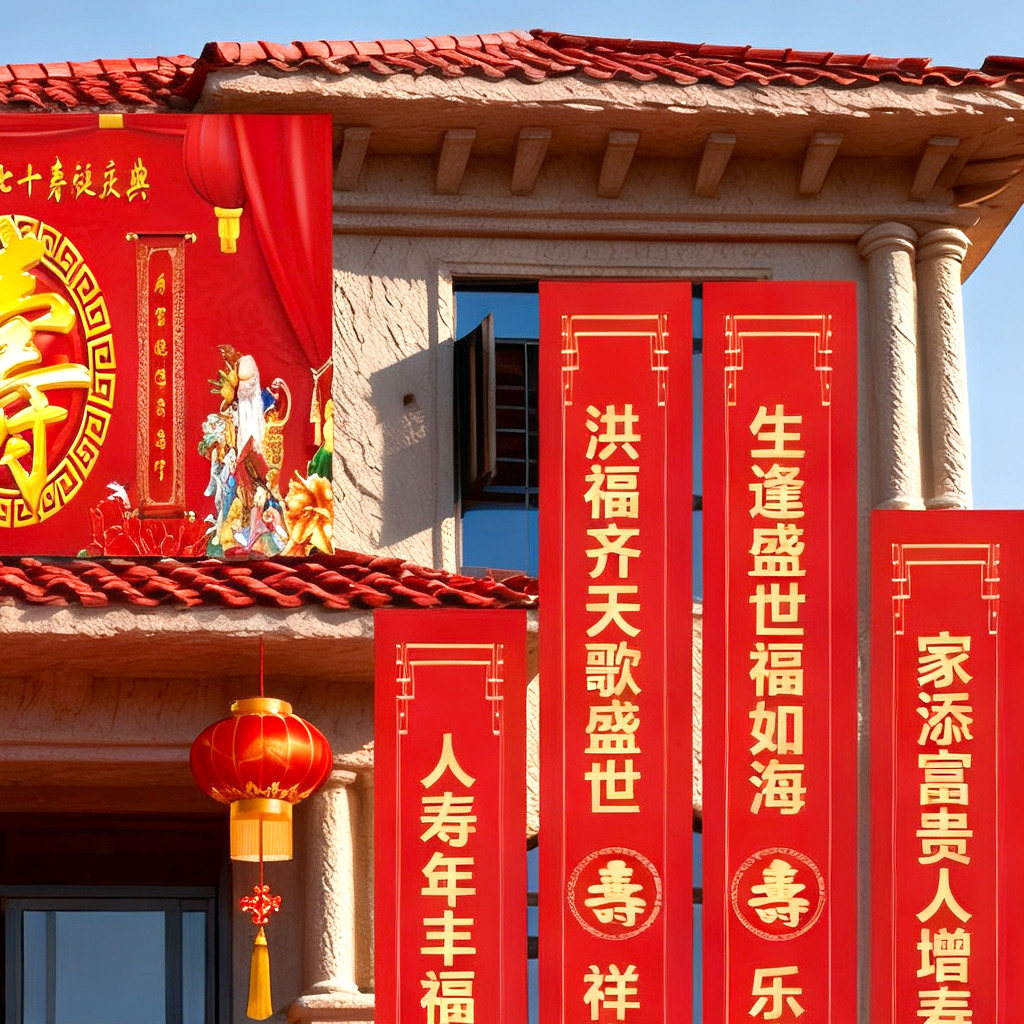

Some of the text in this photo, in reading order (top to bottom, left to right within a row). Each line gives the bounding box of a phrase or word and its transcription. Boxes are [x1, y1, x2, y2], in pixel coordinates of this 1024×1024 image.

[584, 404, 641, 812] 洪福齐天歌盛世
[748, 405, 806, 814] 生逢盛世福如海
